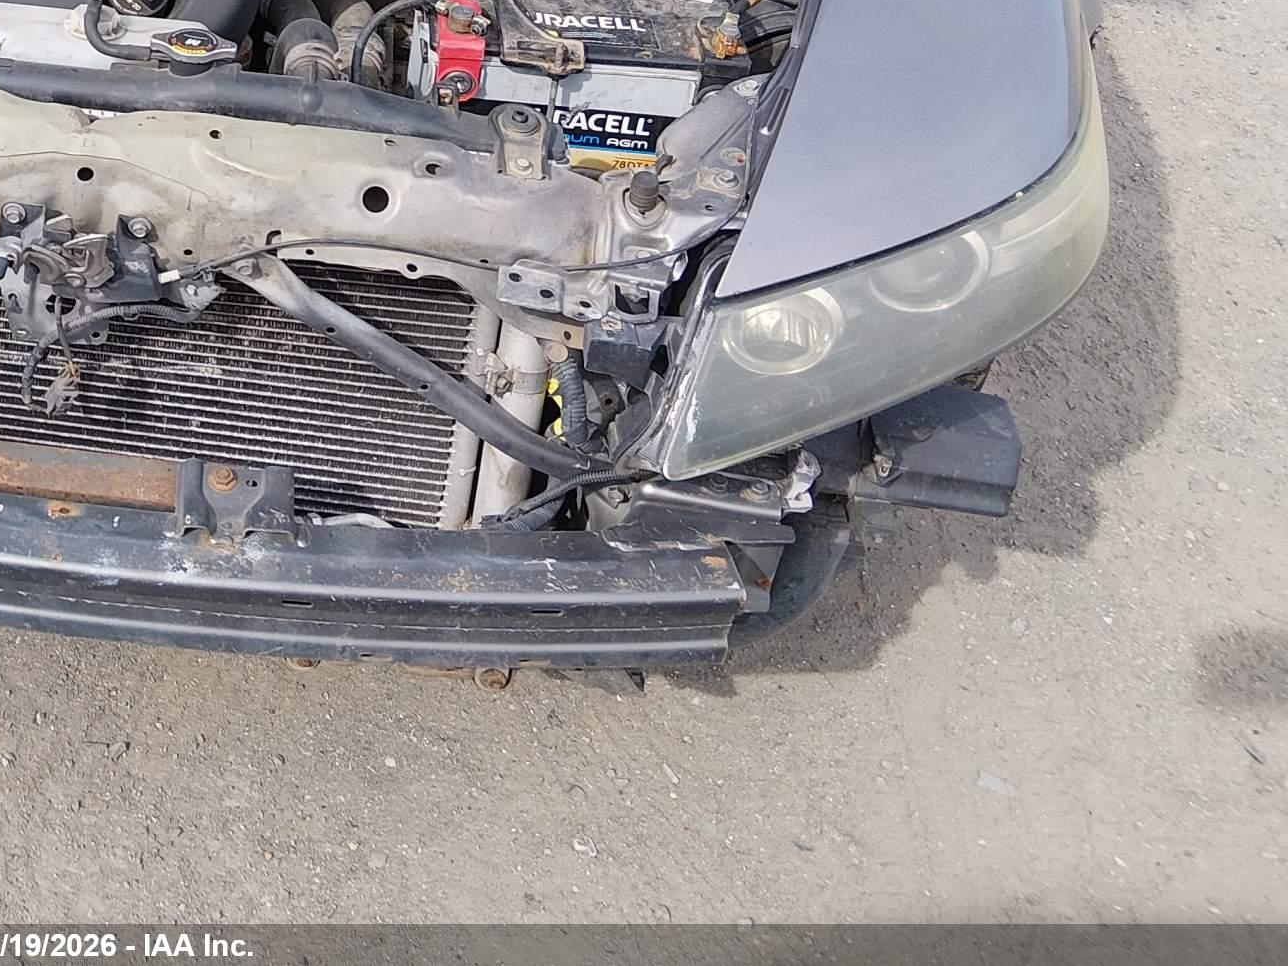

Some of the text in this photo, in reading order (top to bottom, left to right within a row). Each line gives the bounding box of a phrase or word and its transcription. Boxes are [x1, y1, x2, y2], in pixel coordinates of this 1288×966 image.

[527, 12, 646, 32] URACELL
[552, 109, 650, 136] RACELL
[606, 137, 648, 149] AGM
